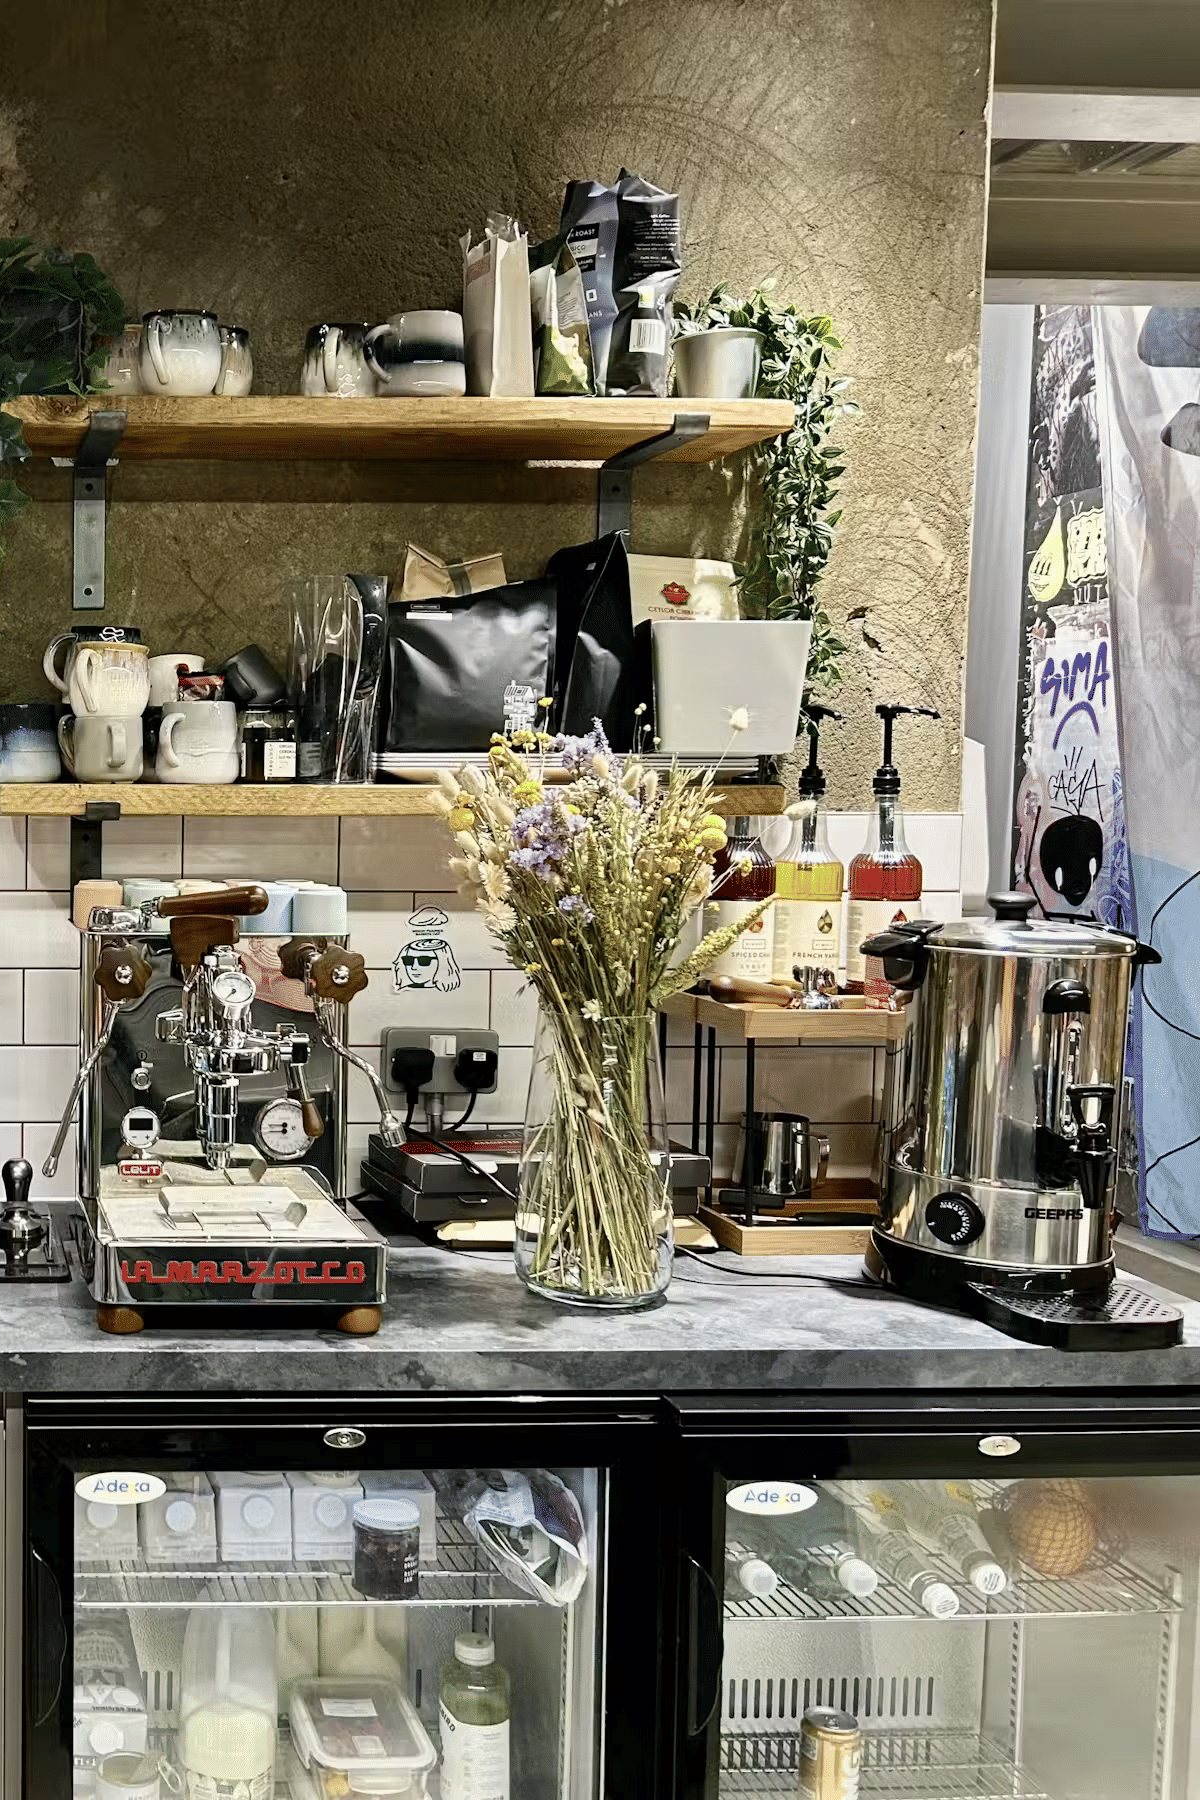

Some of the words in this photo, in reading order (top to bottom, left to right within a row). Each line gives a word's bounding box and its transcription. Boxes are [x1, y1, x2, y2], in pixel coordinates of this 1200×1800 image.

[575, 228, 595, 236] ROAST
[1025, 1207, 1084, 1220] GEEPAS
[122, 1260, 153, 1283] LA
